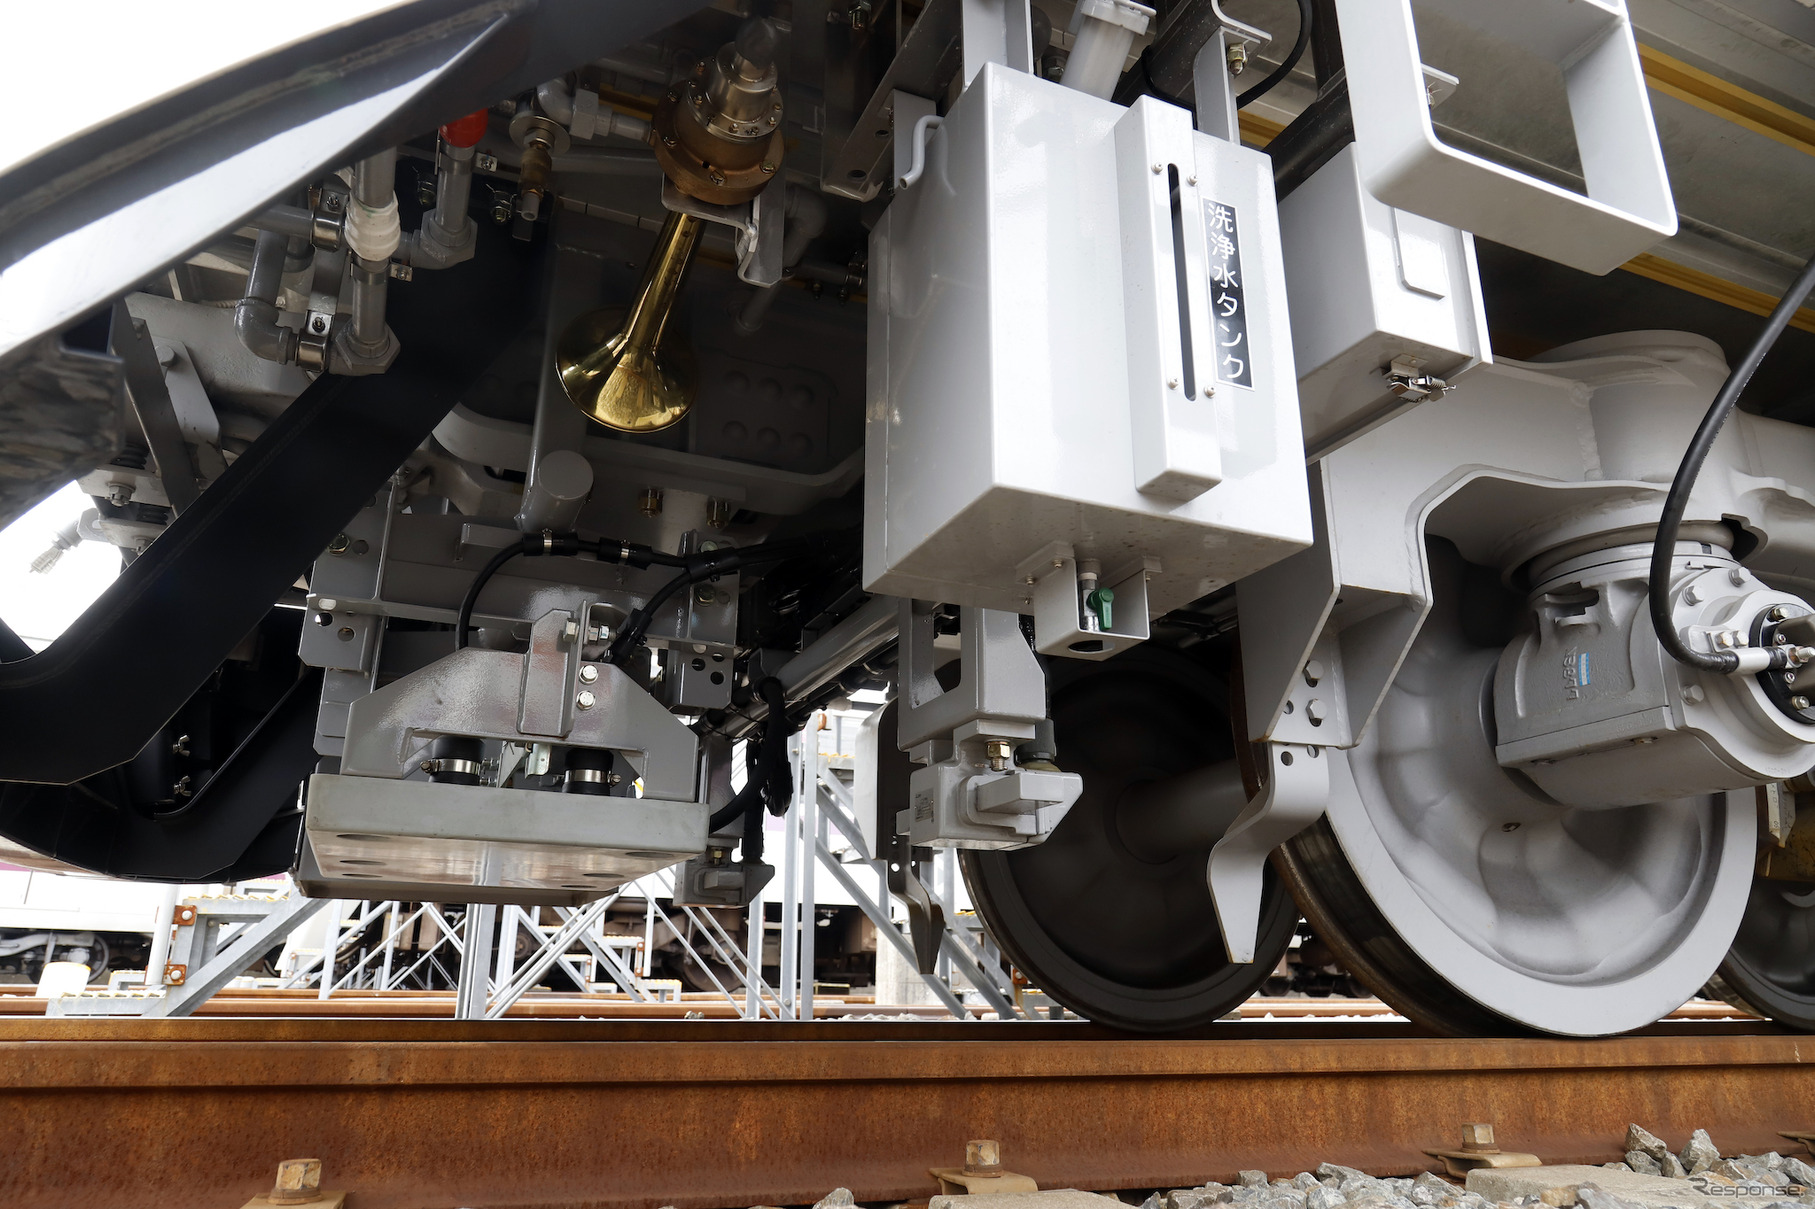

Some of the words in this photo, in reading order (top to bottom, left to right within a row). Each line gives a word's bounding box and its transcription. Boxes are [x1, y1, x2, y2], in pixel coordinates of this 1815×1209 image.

[1207, 202, 1244, 379] 洗浄水タンク
